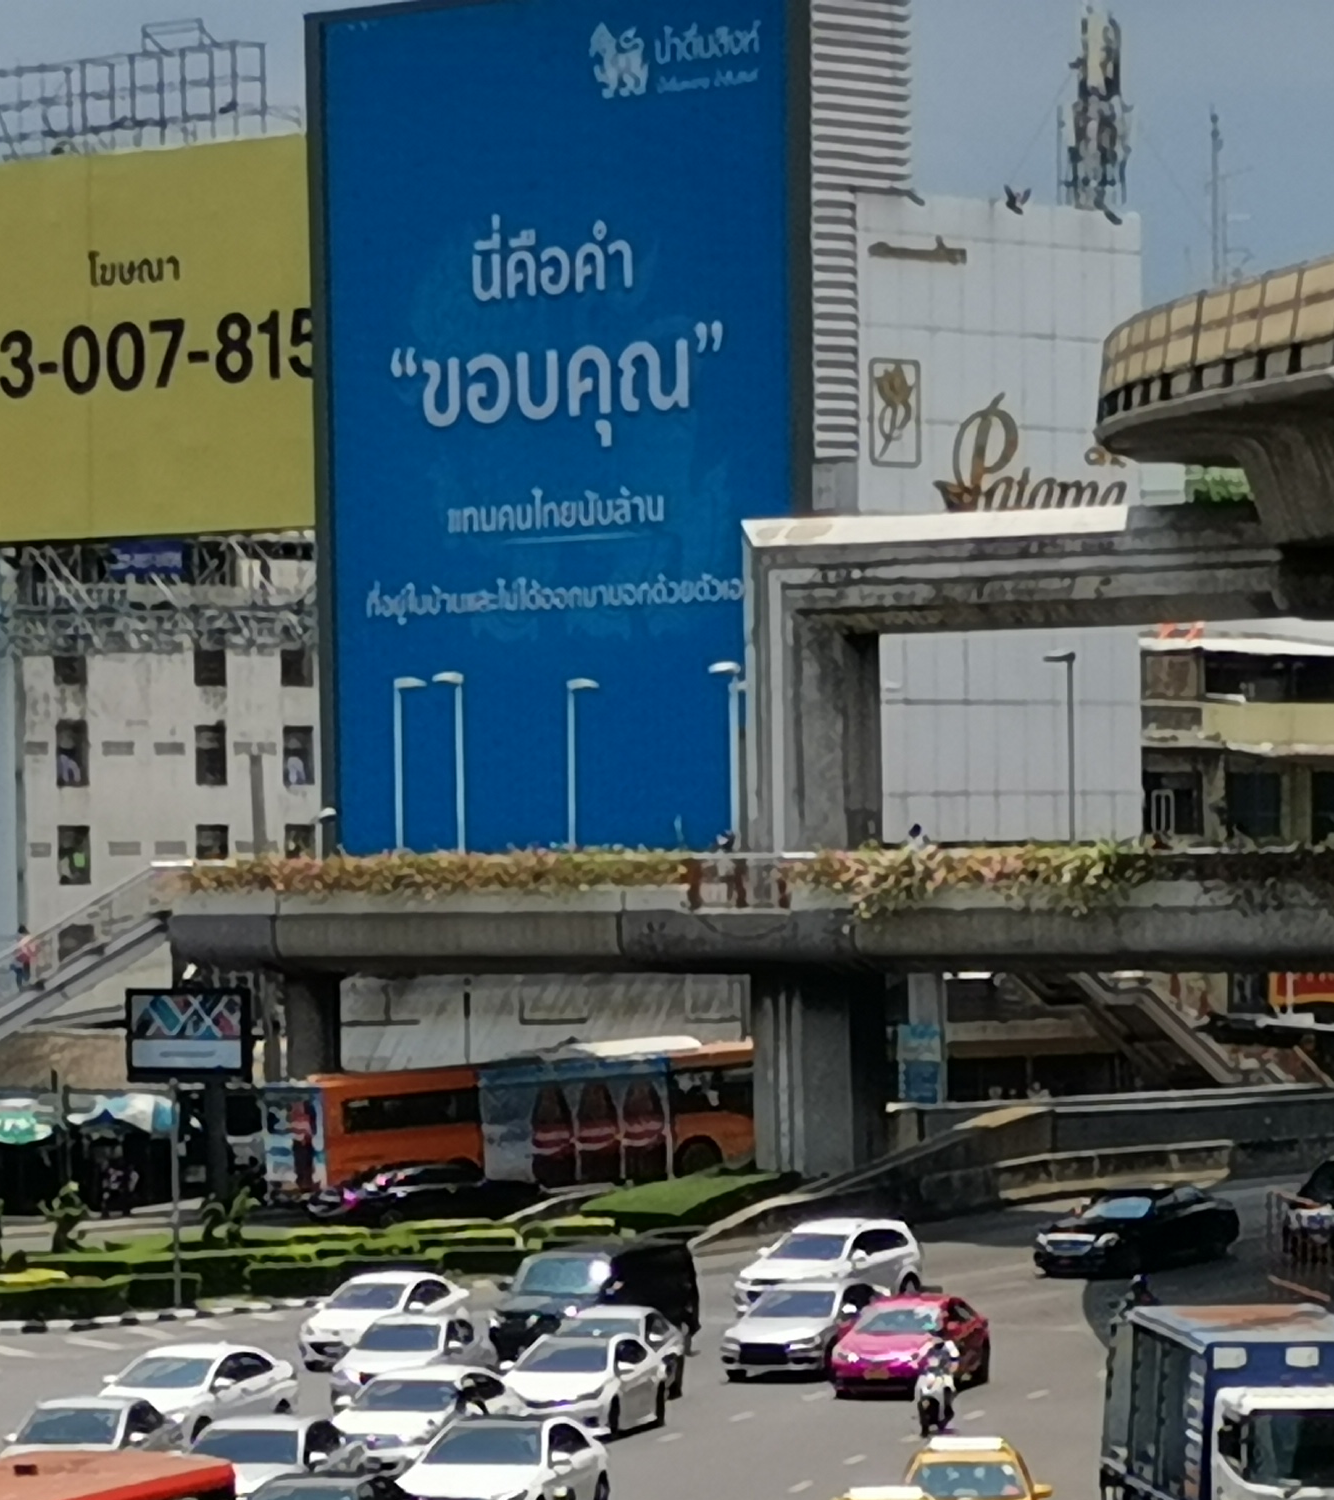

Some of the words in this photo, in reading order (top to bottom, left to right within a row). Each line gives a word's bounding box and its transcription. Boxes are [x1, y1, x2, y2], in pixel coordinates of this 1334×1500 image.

[87, 250, 181, 287] โฆษณา
[471, 213, 634, 302] นี่คือคำ
[447, 487, 665, 534] แทนคนไทยนับล้าน
